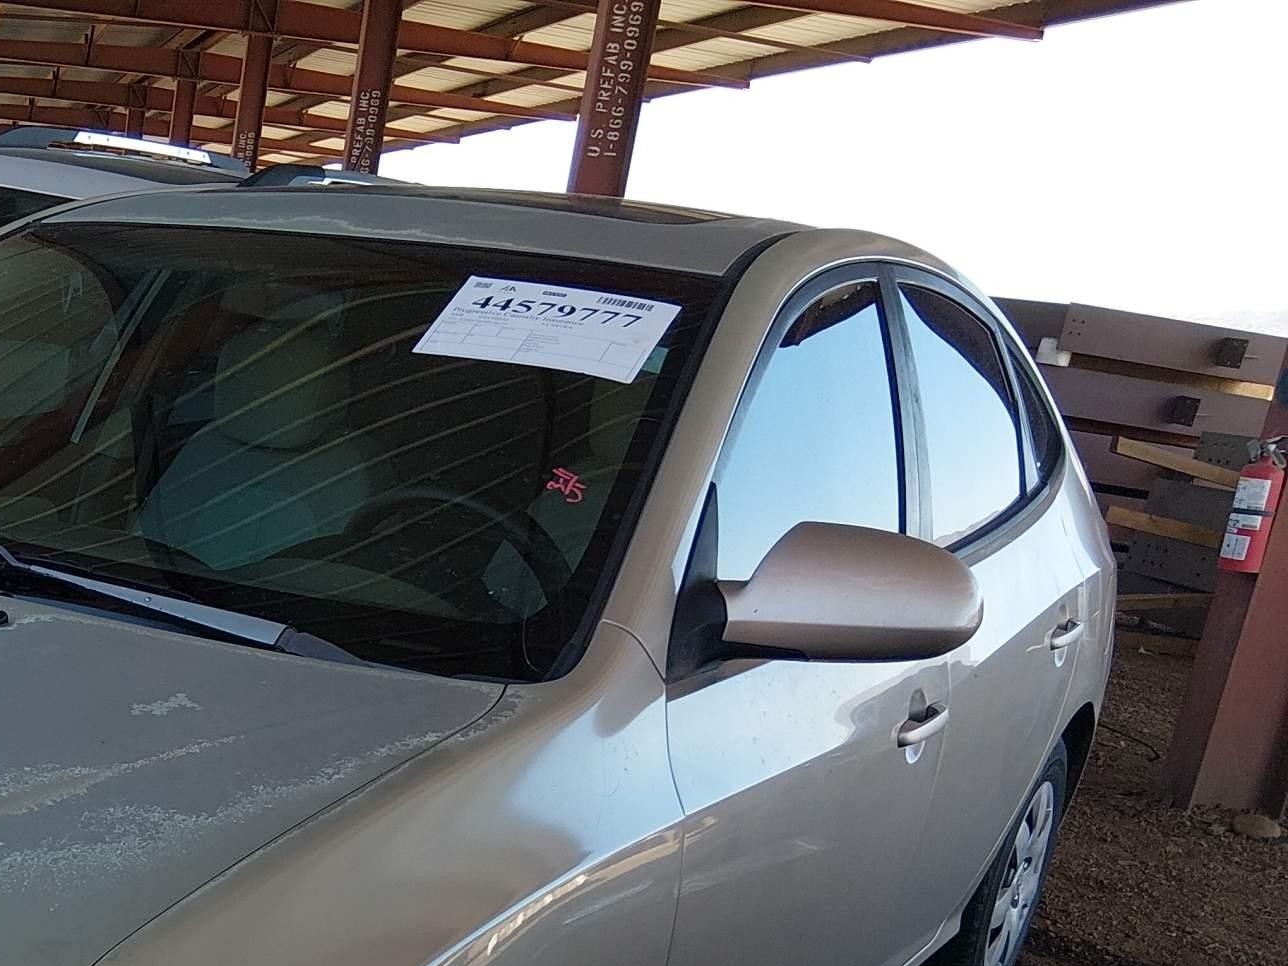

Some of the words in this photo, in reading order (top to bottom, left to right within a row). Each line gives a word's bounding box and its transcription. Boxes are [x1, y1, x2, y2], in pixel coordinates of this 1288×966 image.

[358, 88, 371, 112] INC.
[596, 42, 620, 113] PREFAB
[603, 0, 645, 157] 1-866-799-0969
[350, 117, 368, 163] PREFAB
[472, 295, 642, 328] 44579777
